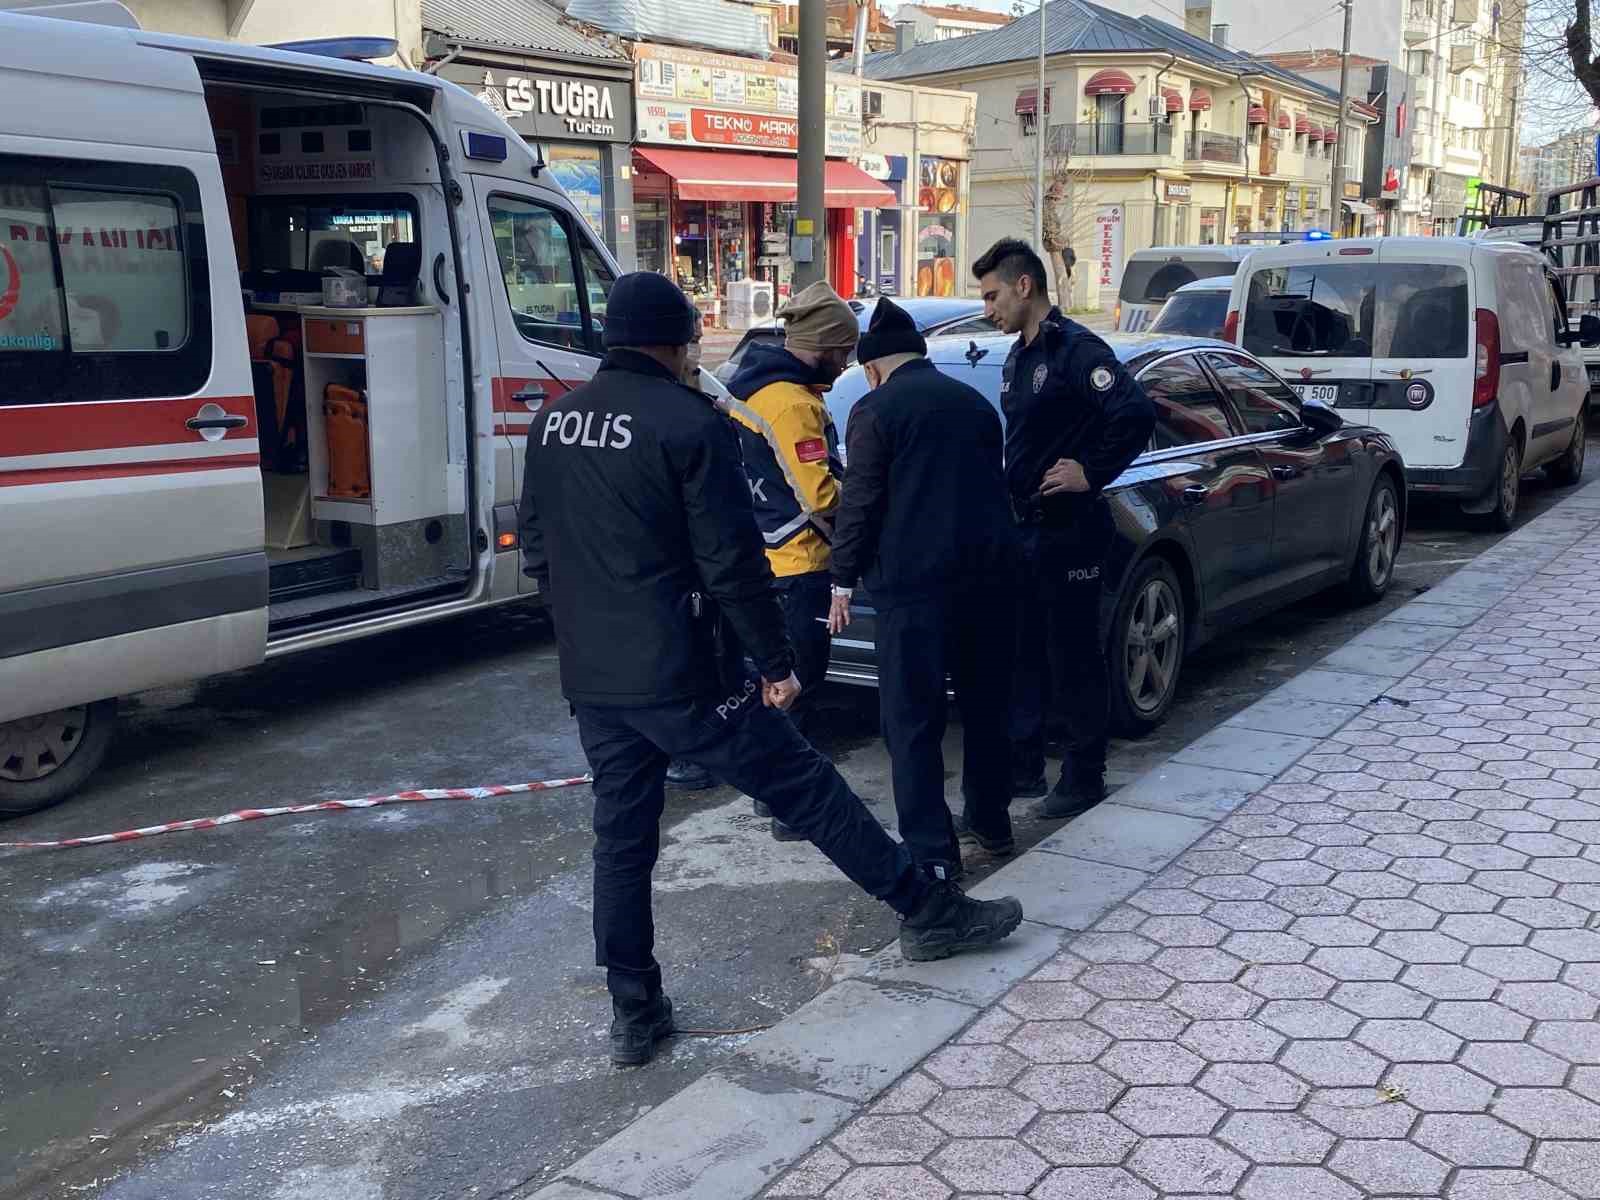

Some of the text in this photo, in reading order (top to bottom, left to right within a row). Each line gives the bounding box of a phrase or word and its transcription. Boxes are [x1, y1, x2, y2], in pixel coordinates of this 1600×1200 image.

[536, 79, 614, 119] TUĞRA
[566, 117, 614, 134] Turizm
[704, 113, 752, 132] TEKNO
[1102, 224, 1112, 284] ELEKTRİK
[1311, 386, 1334, 399] 500
